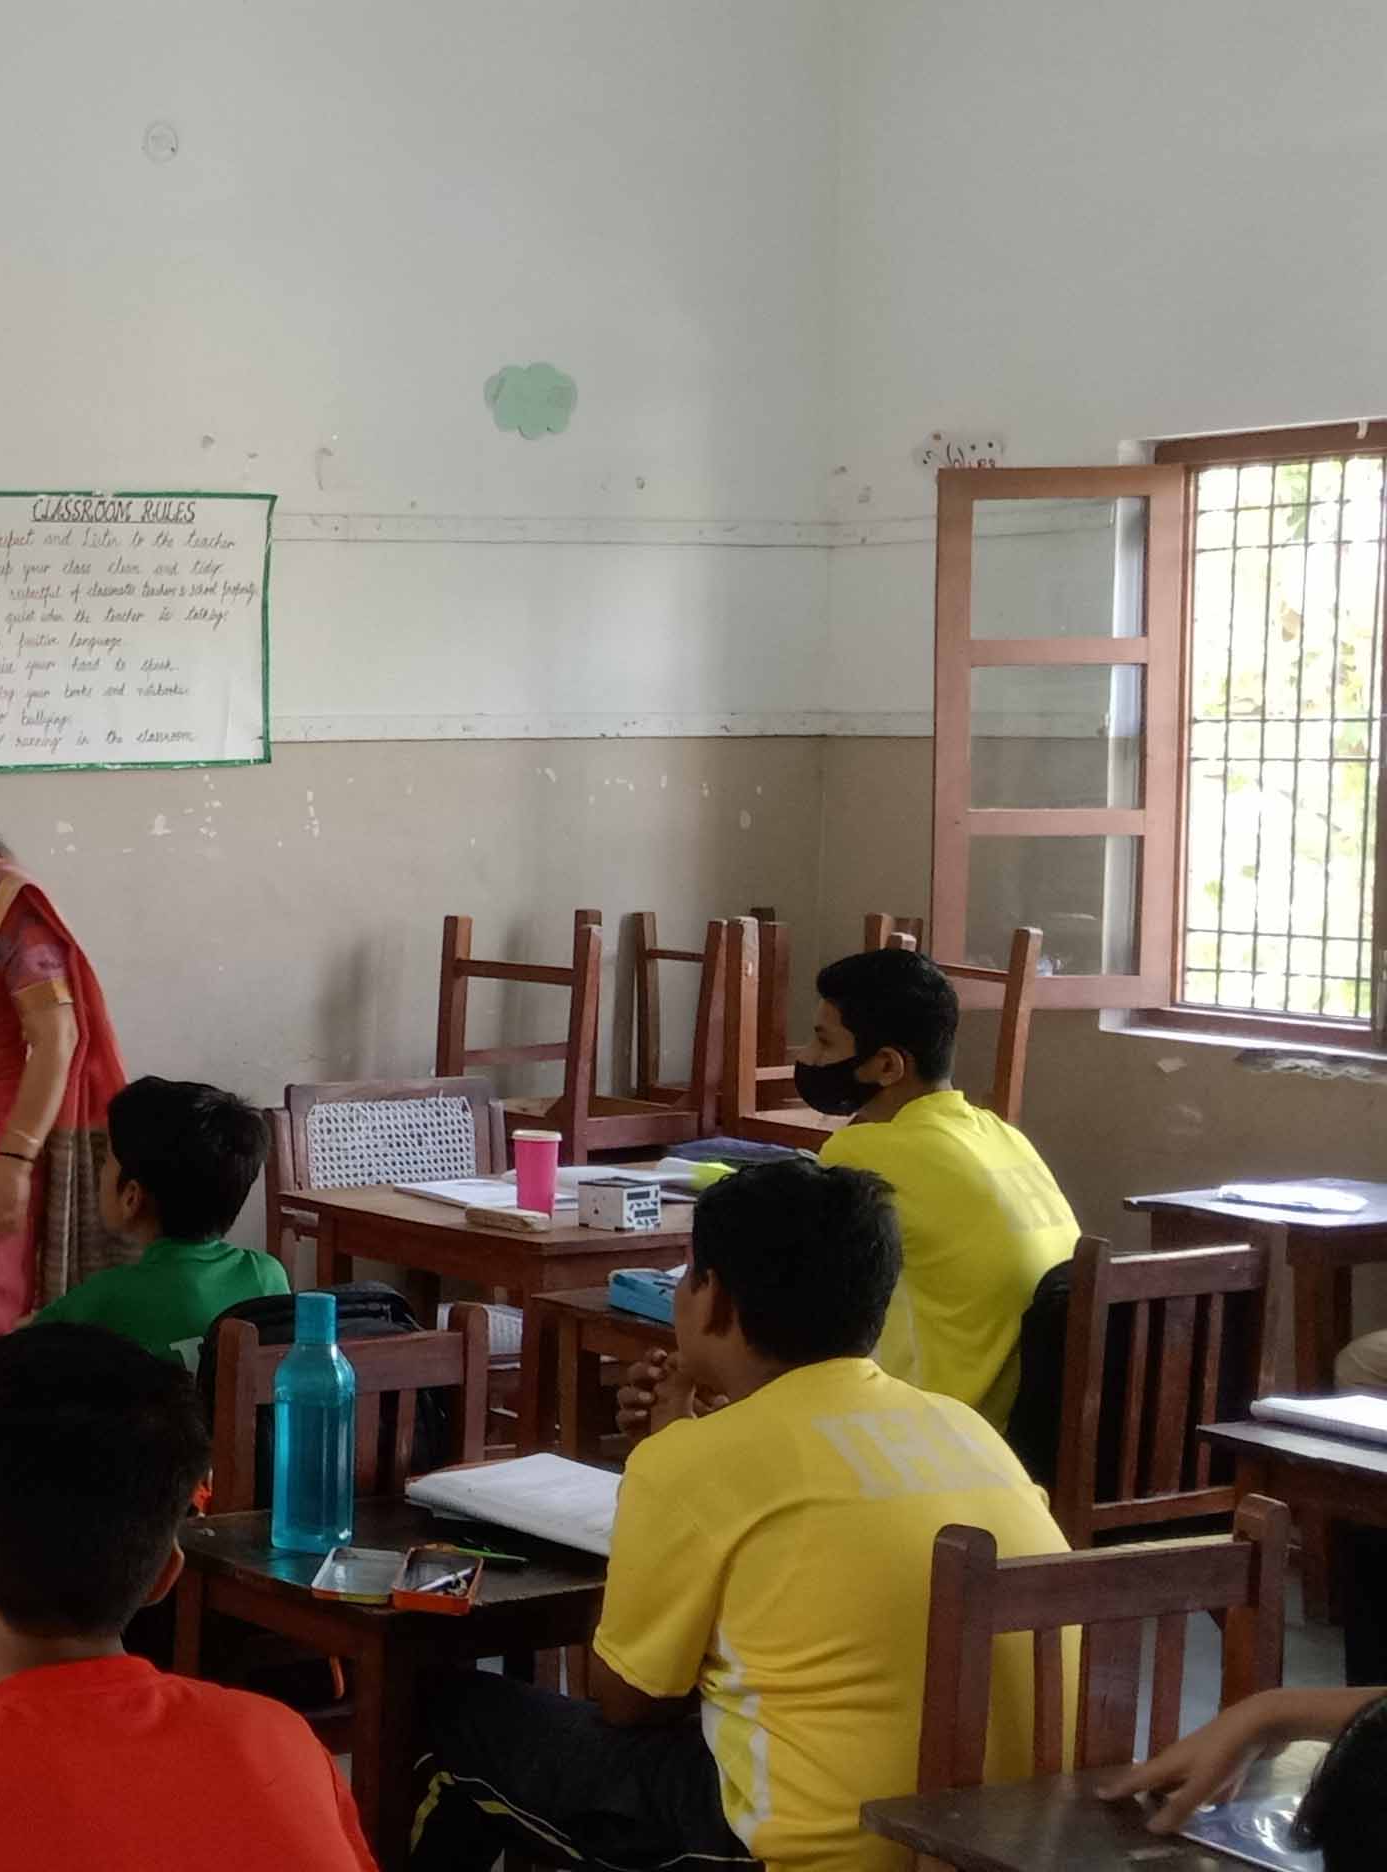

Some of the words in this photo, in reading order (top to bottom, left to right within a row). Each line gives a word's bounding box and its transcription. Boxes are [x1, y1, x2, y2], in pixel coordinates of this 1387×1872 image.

[33, 499, 132, 522] CLASSROOM
[143, 501, 196, 523] RULES
[43, 528, 73, 546] and
[155, 530, 175, 546] the
[187, 529, 237, 550] teacher
[23, 561, 53, 583] your
[62, 557, 92, 575] class
[107, 555, 142, 576] clean
[152, 559, 180, 576] and
[5, 606, 37, 633] quiet
[75, 606, 92, 624] the
[103, 606, 146, 624] teacher
[25, 659, 57, 683] your
[71, 656, 102, 672] hand
[63, 684, 94, 699] books
